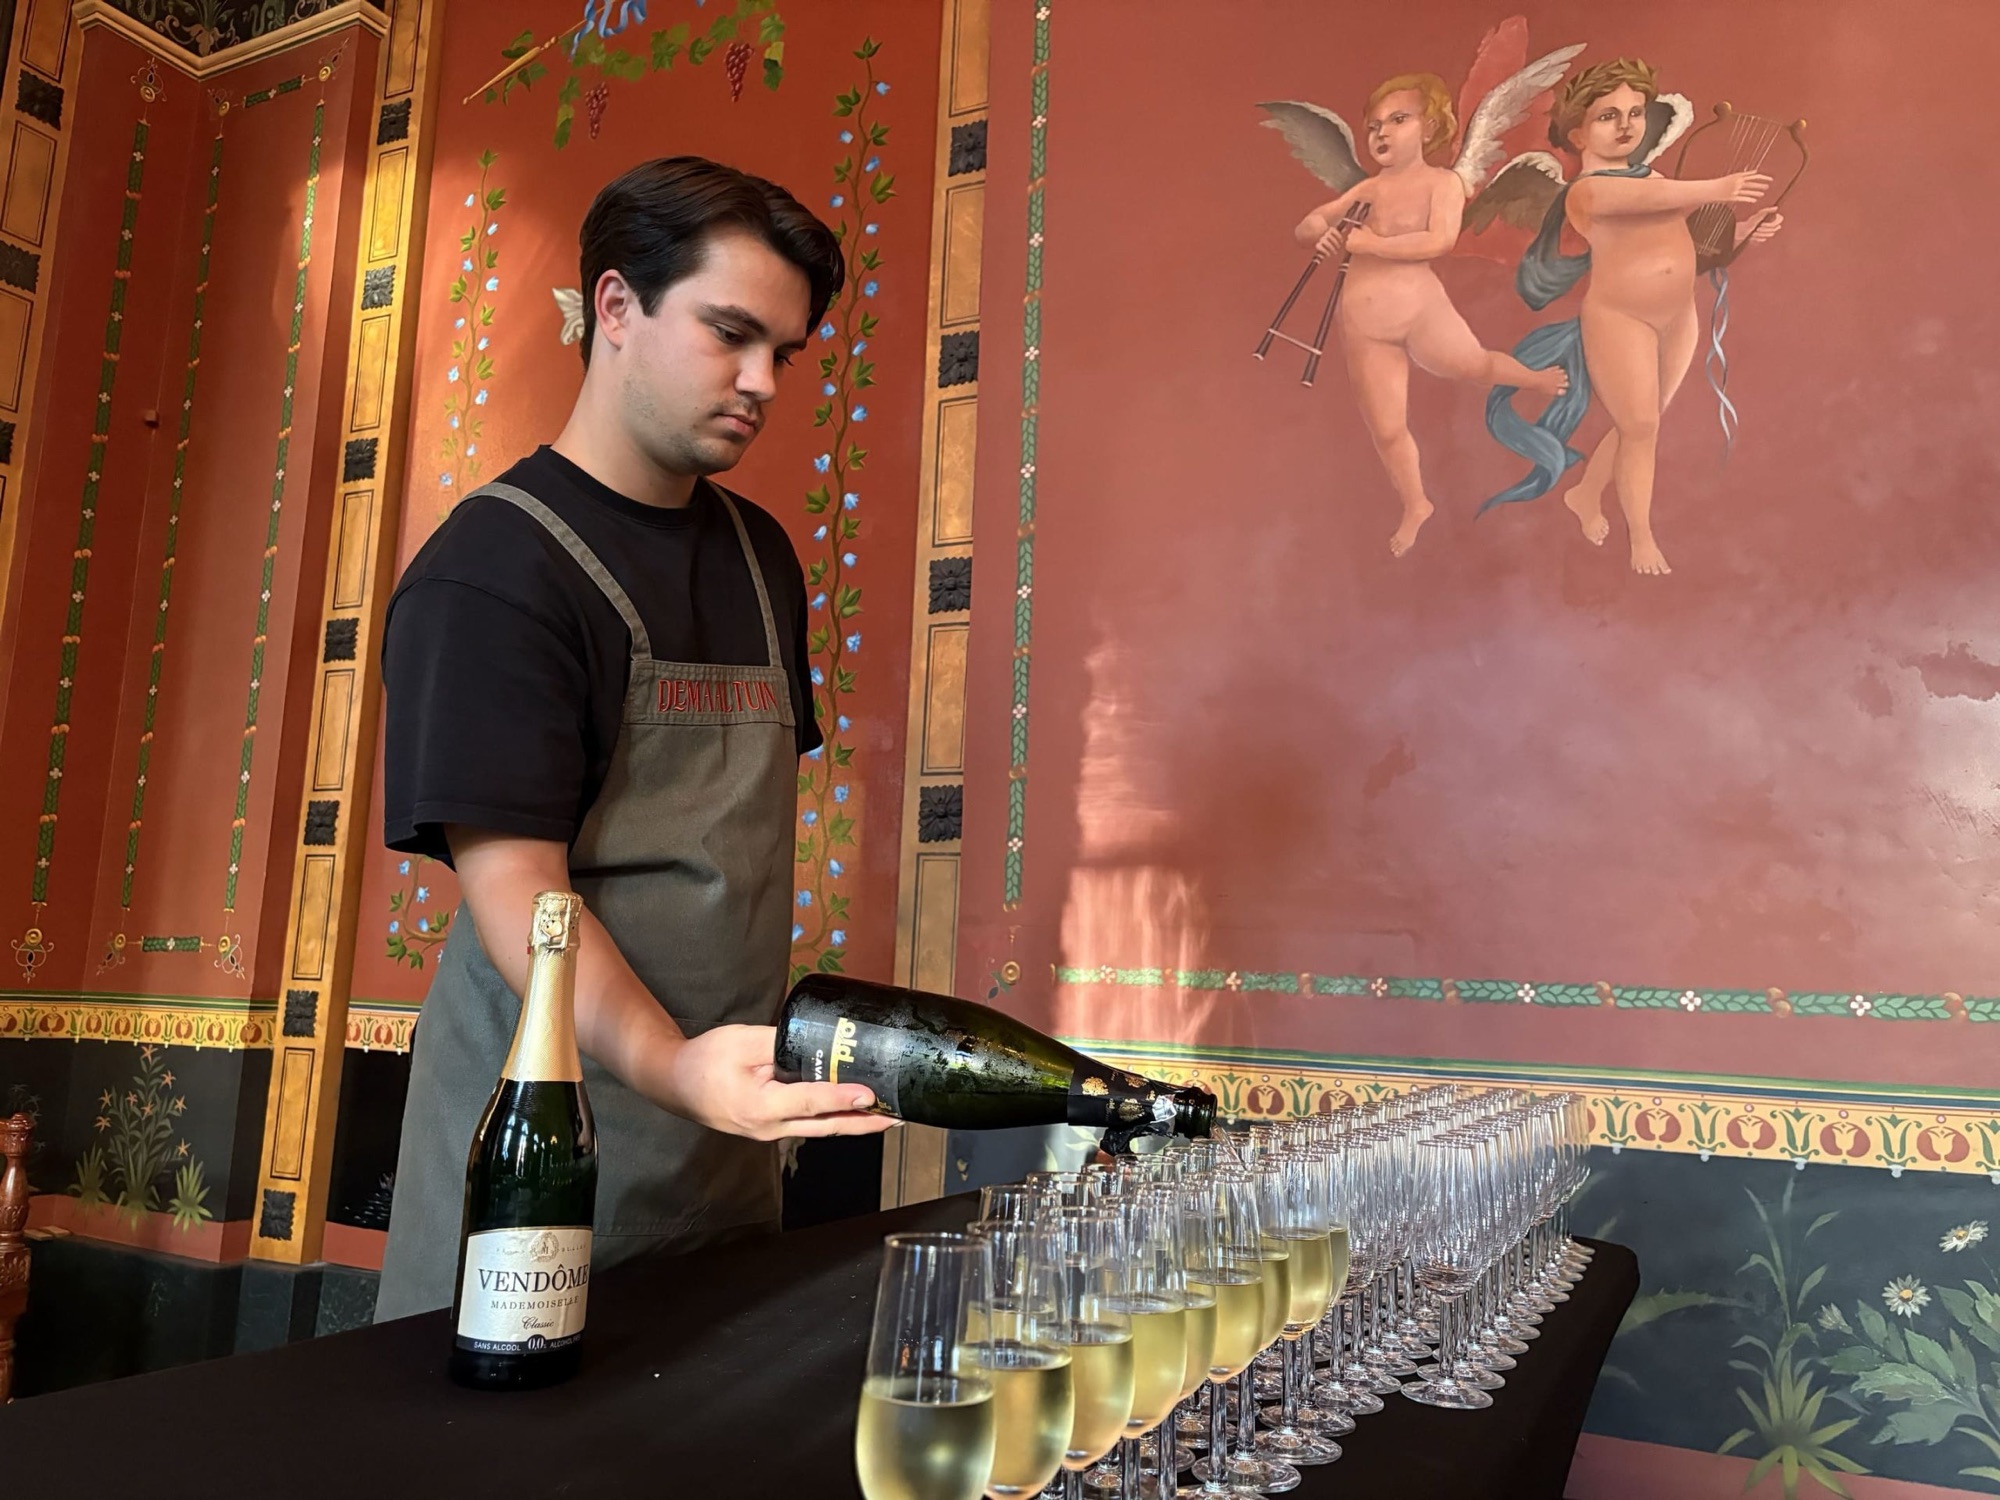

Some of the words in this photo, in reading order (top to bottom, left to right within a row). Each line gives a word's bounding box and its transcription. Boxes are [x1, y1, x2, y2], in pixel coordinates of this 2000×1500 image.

[815, 1049, 823, 1080] CAVA
[478, 1264, 589, 1293] VENDÔME
[491, 1296, 580, 1310] MADEMOISELLE
[521, 1316, 555, 1330] Classic
[474, 1341, 491, 1350] SANS
[493, 1342, 521, 1351] ALCOOL
